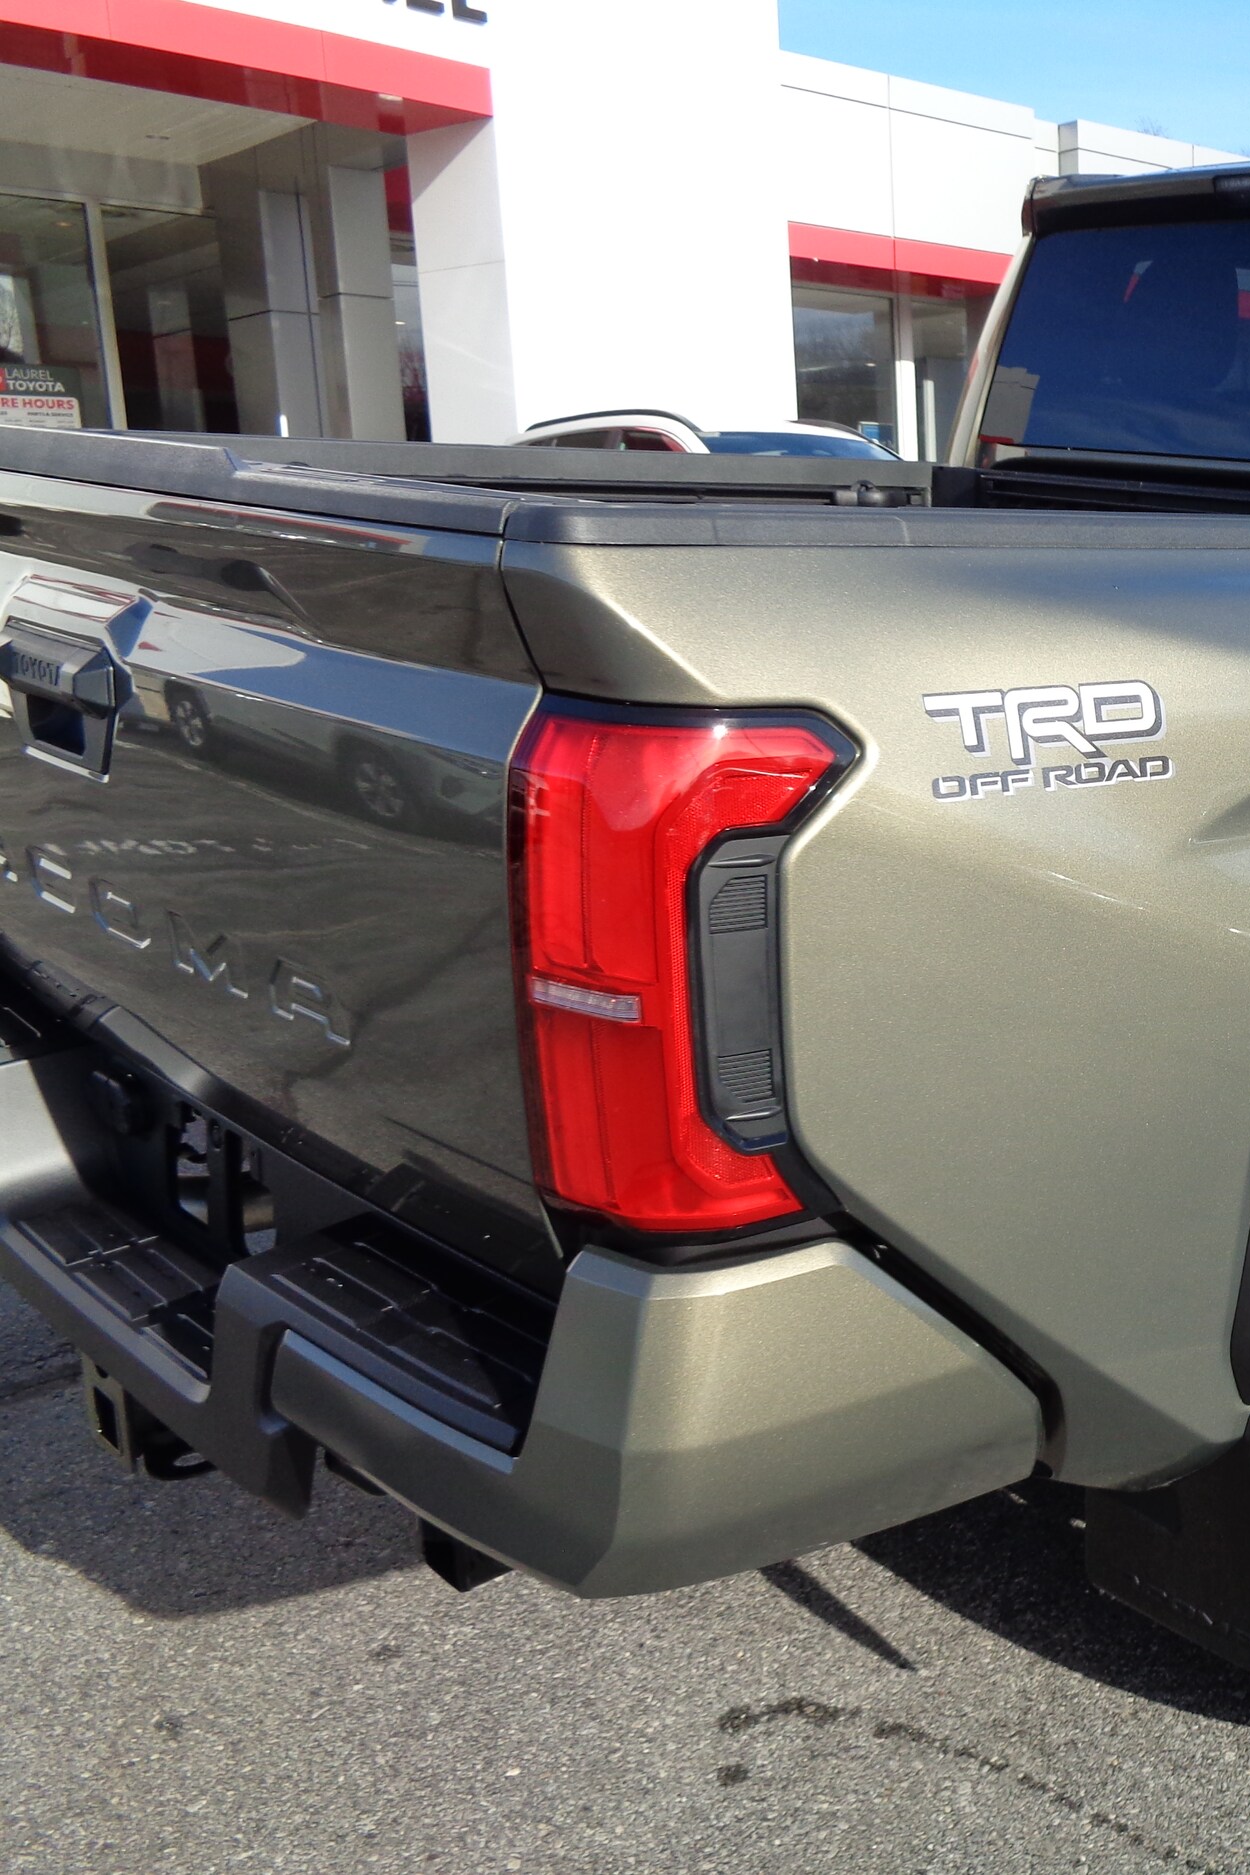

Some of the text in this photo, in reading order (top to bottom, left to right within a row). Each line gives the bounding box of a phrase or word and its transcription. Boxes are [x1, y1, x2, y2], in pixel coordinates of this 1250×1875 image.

[4, 367, 54, 380] LAUREL
[7, 380, 65, 392] TOYOTA
[22, 399, 75, 410] HOURS
[921, 679, 1168, 767] TRD
[931, 755, 1175, 802] OFF ROAD
[0, 834, 350, 1046] COMA
